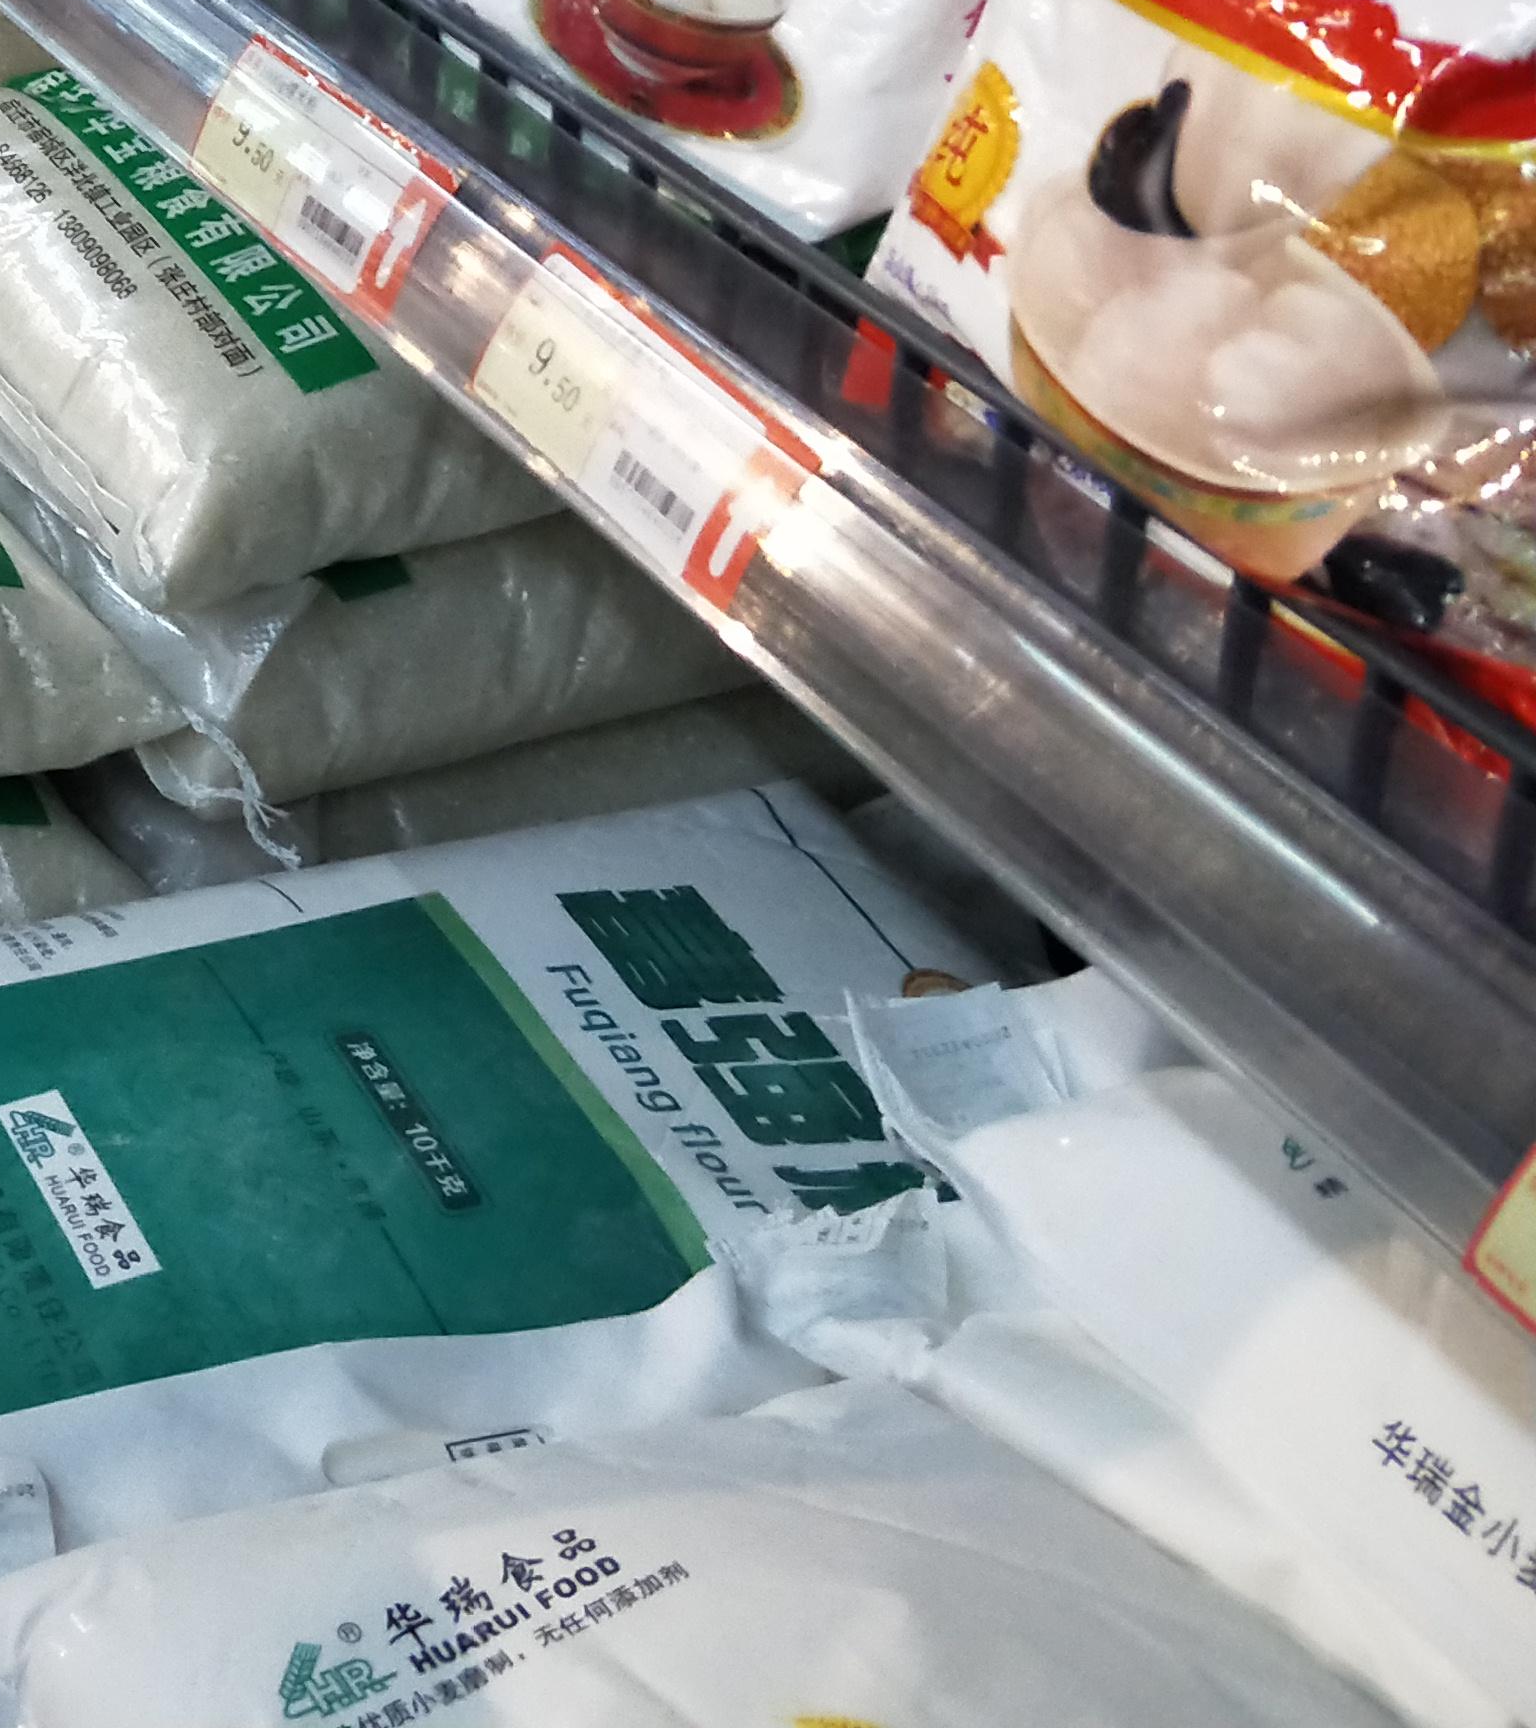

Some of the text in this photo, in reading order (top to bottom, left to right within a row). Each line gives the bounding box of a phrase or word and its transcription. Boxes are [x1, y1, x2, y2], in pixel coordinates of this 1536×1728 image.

[527, 336, 583, 414] 9.50
[545, 961, 774, 1218] Fuqiang flour
[402, 1121, 473, 1202] 10千克
[44, 1172, 112, 1280] HUARUI FOOD
[66, 1164, 143, 1272] 华瑞食品
[385, 1527, 598, 1648] 华瑞食品
[410, 1554, 622, 1674] HUARUI FOOD
[534, 1558, 691, 1649] 无任何添加剂
